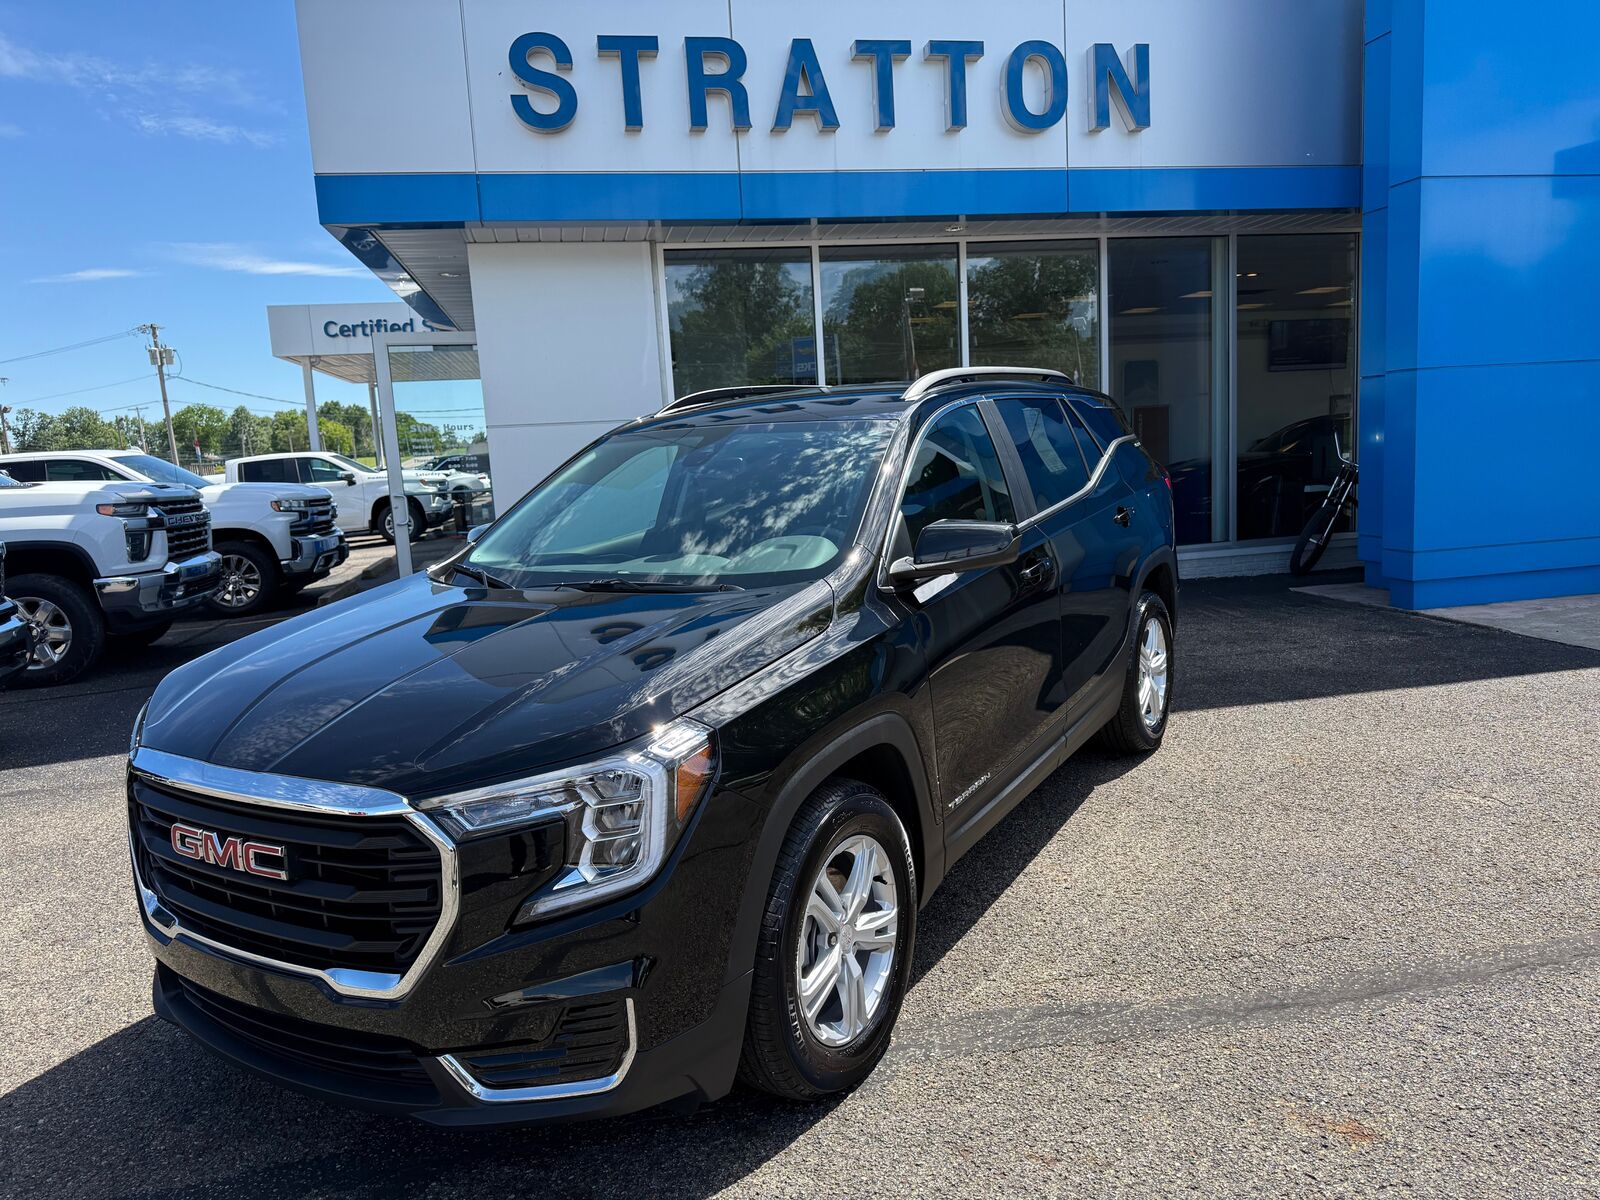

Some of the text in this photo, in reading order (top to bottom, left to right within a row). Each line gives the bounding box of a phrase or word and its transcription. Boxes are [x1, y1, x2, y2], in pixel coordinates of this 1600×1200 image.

[508, 31, 1150, 134] STRATTON
[323, 318, 414, 338] Certified
[410, 423, 474, 433] Store Hours
[949, 772, 991, 809] TERRAIN
[170, 822, 287, 880] GMC
